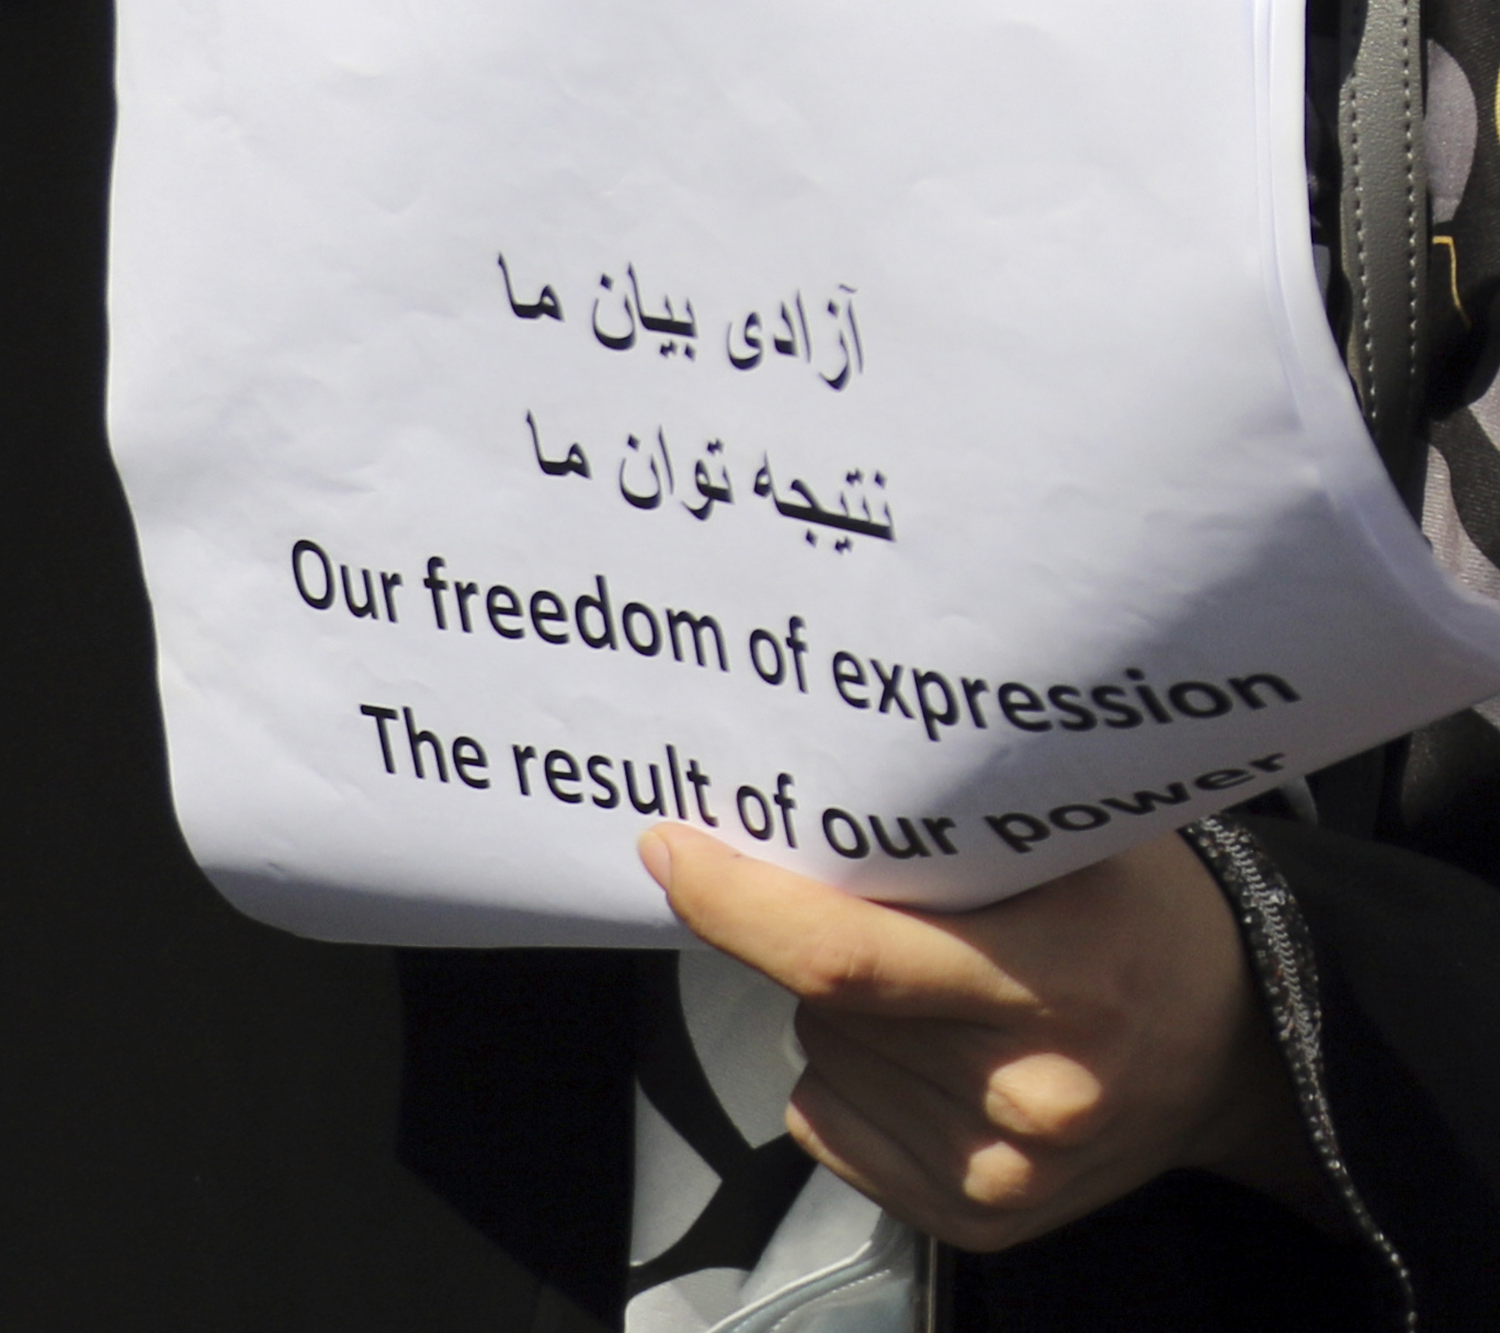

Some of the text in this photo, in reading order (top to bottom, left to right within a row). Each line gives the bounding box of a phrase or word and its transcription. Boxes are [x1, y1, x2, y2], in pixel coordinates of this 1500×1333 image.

[498, 254, 863, 391] آزادی بیان ما
[526, 412, 896, 556] نتیجه توان ما
[292, 540, 1301, 742] Our freedom of expression
[360, 704, 1288, 859] The result of our power
